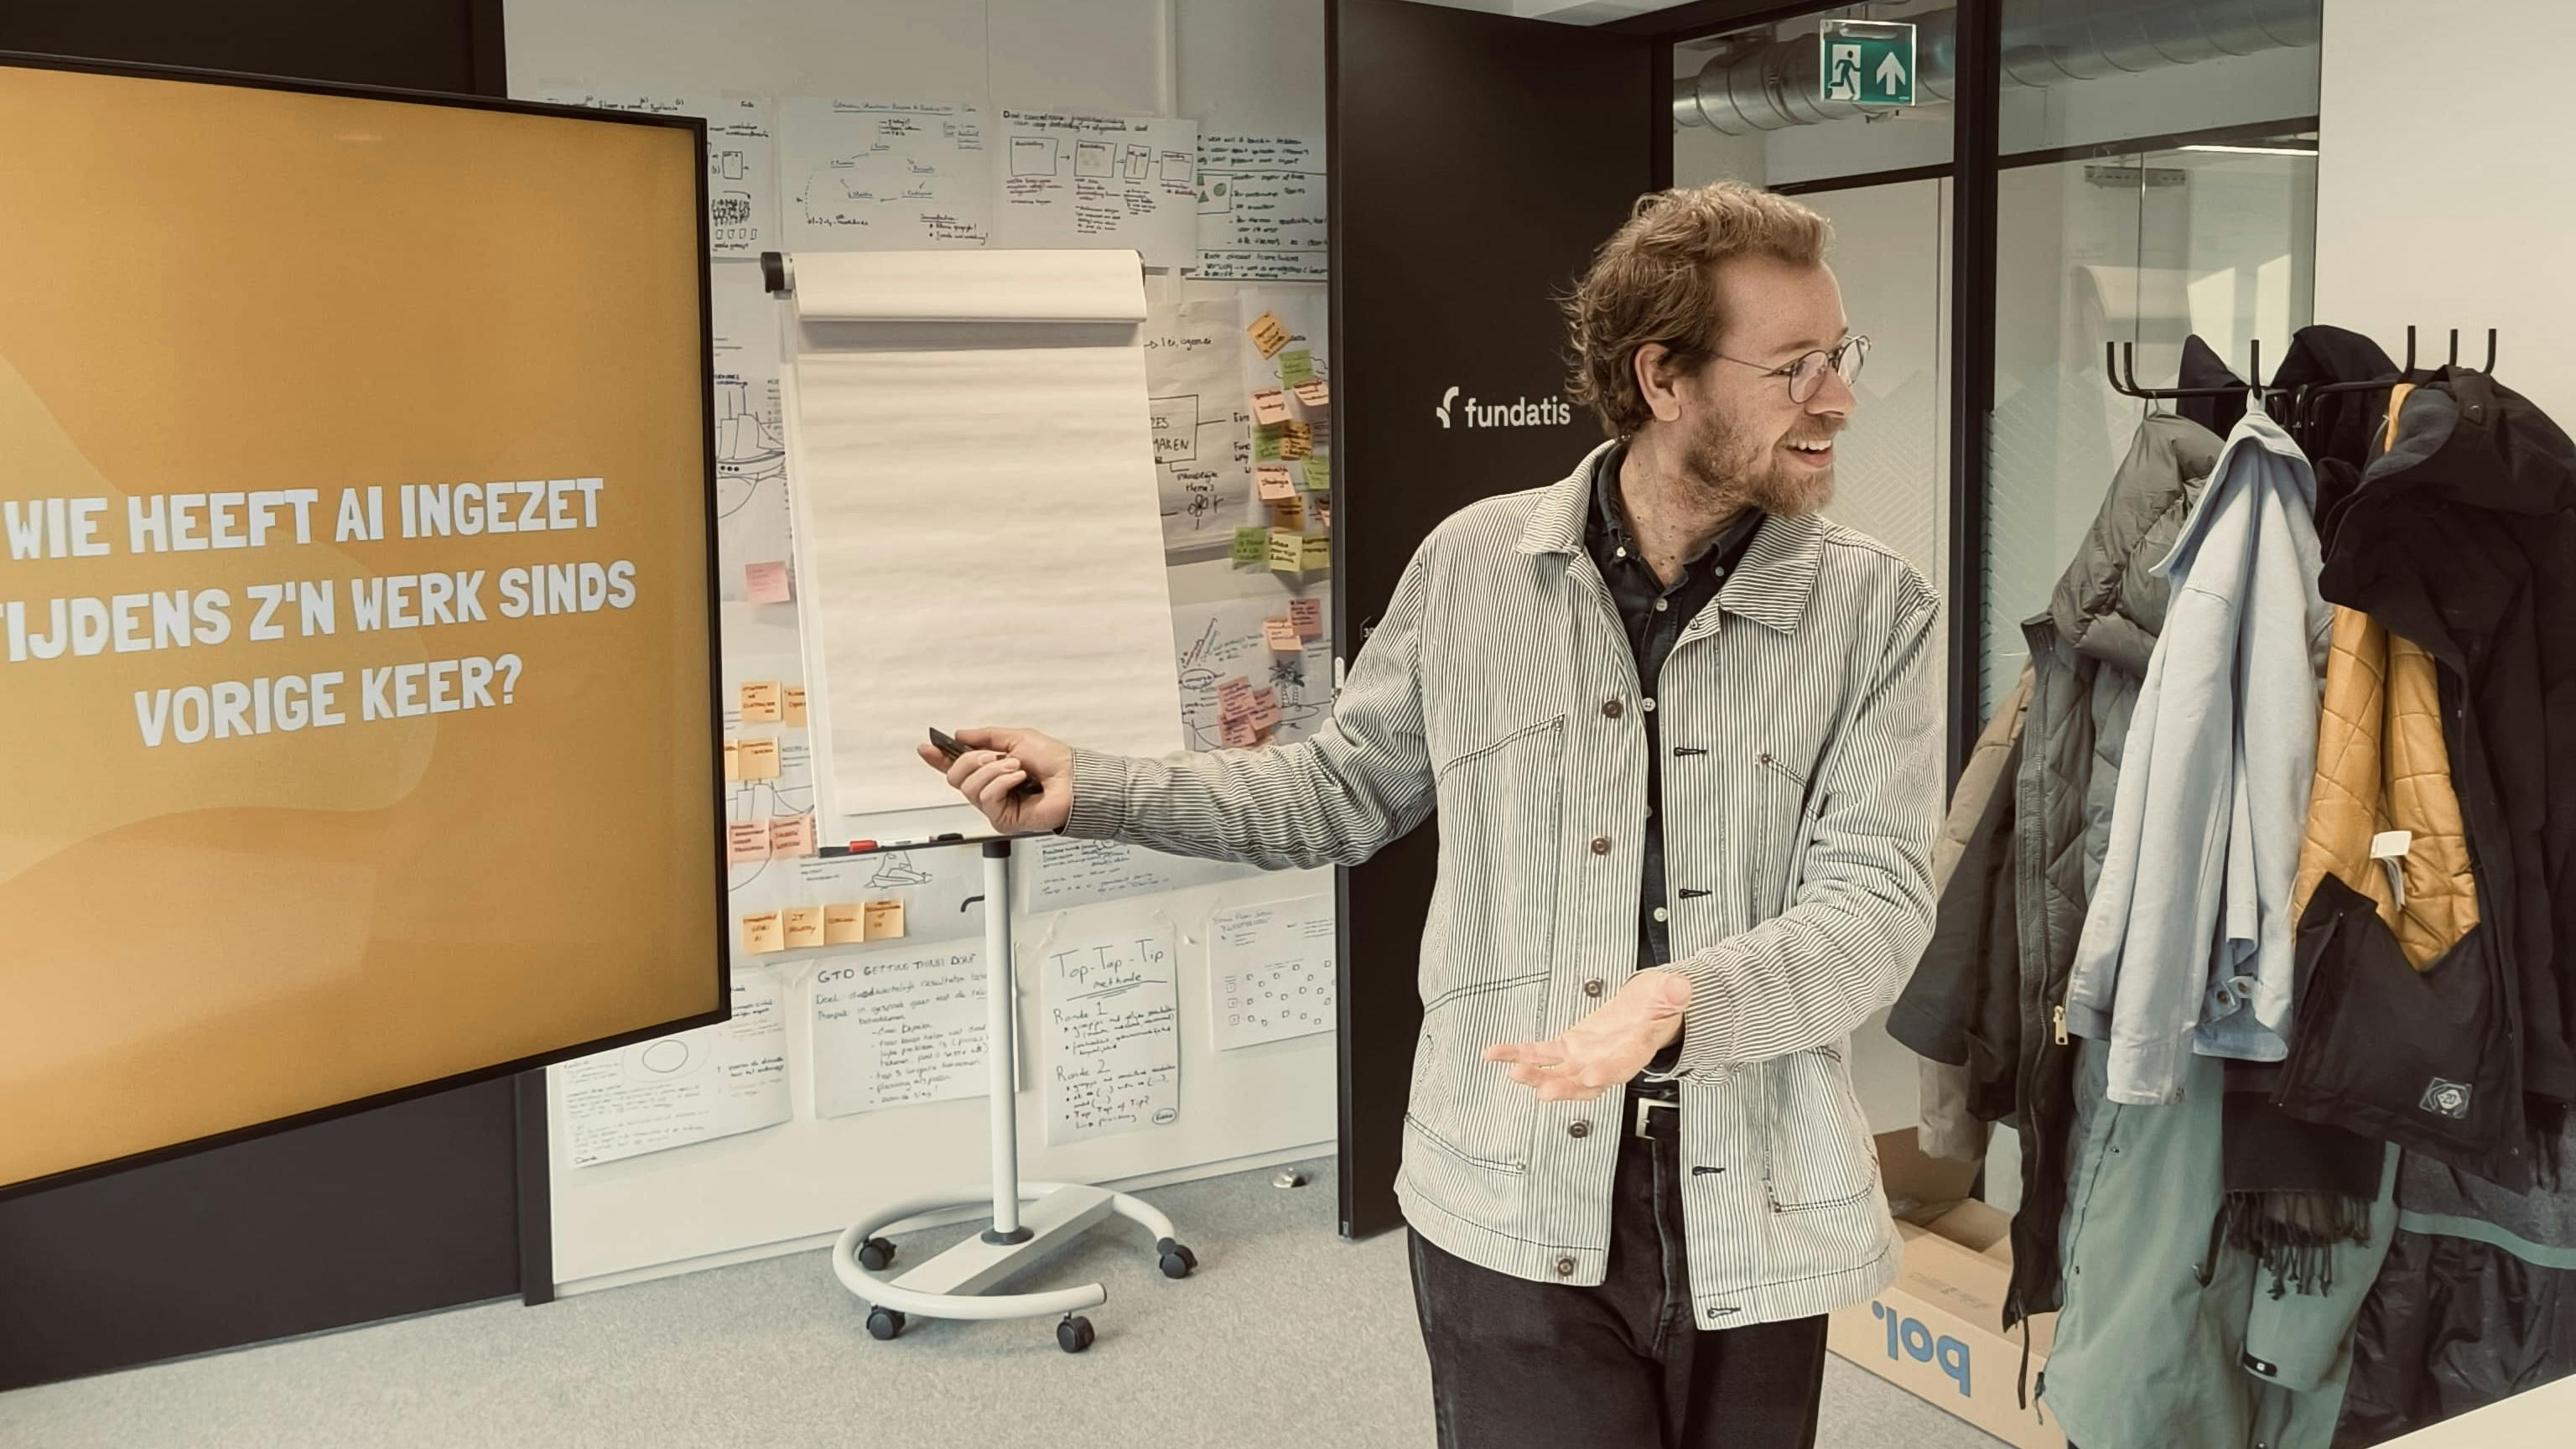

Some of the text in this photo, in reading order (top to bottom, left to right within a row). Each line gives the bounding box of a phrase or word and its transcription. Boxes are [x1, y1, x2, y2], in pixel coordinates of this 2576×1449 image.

[1464, 395, 1571, 428] fundatis
[3, 477, 604, 560] WIE HEEFT AI INGEZET
[0, 560, 636, 663] IJDENS Z'N WERK SINDS
[134, 654, 522, 747] VORIGE KEER?
[1872, 1301, 1971, 1398] bol.
